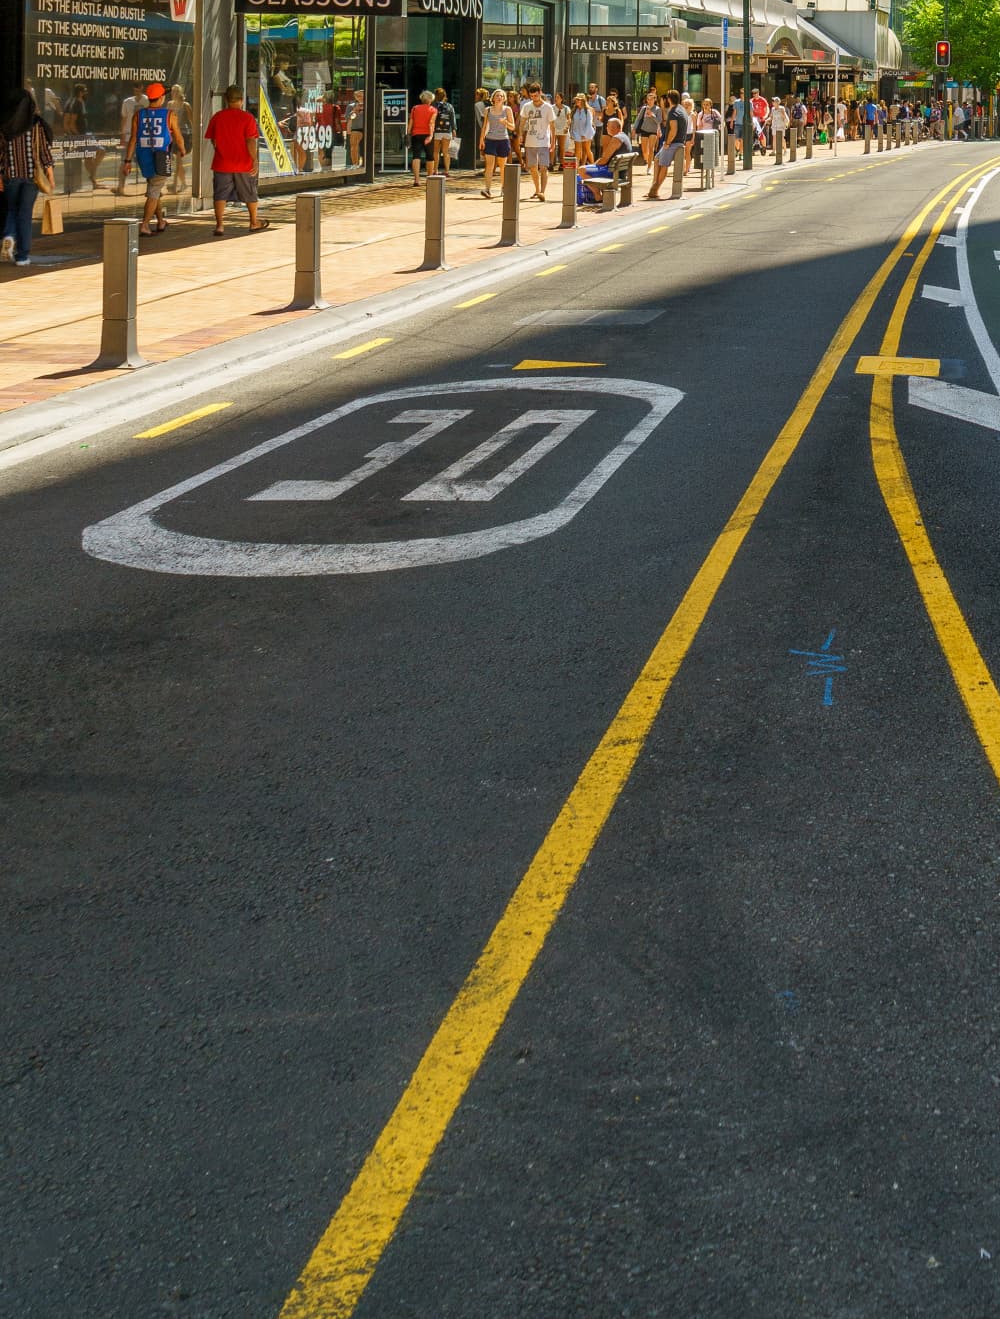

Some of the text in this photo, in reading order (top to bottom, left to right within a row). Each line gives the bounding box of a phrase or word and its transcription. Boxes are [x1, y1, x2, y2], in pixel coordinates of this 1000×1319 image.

[54, 0, 70, 14] THE
[71, 1, 102, 17] HUSTLE
[103, 5, 119, 19] AND
[120, 7, 146, 22] BUSTLE
[38, 19, 148, 42] IT'S THE SHOPPING TIME-OUTS
[37, 41, 125, 60] IT'S THE CAFFEINE HITS
[570, 38, 659, 52] HALLENSTEINS
[37, 63, 166, 82] IT'S THE CATCHING UP WITH FRIENDS
[246, 409, 596, 502] 30
